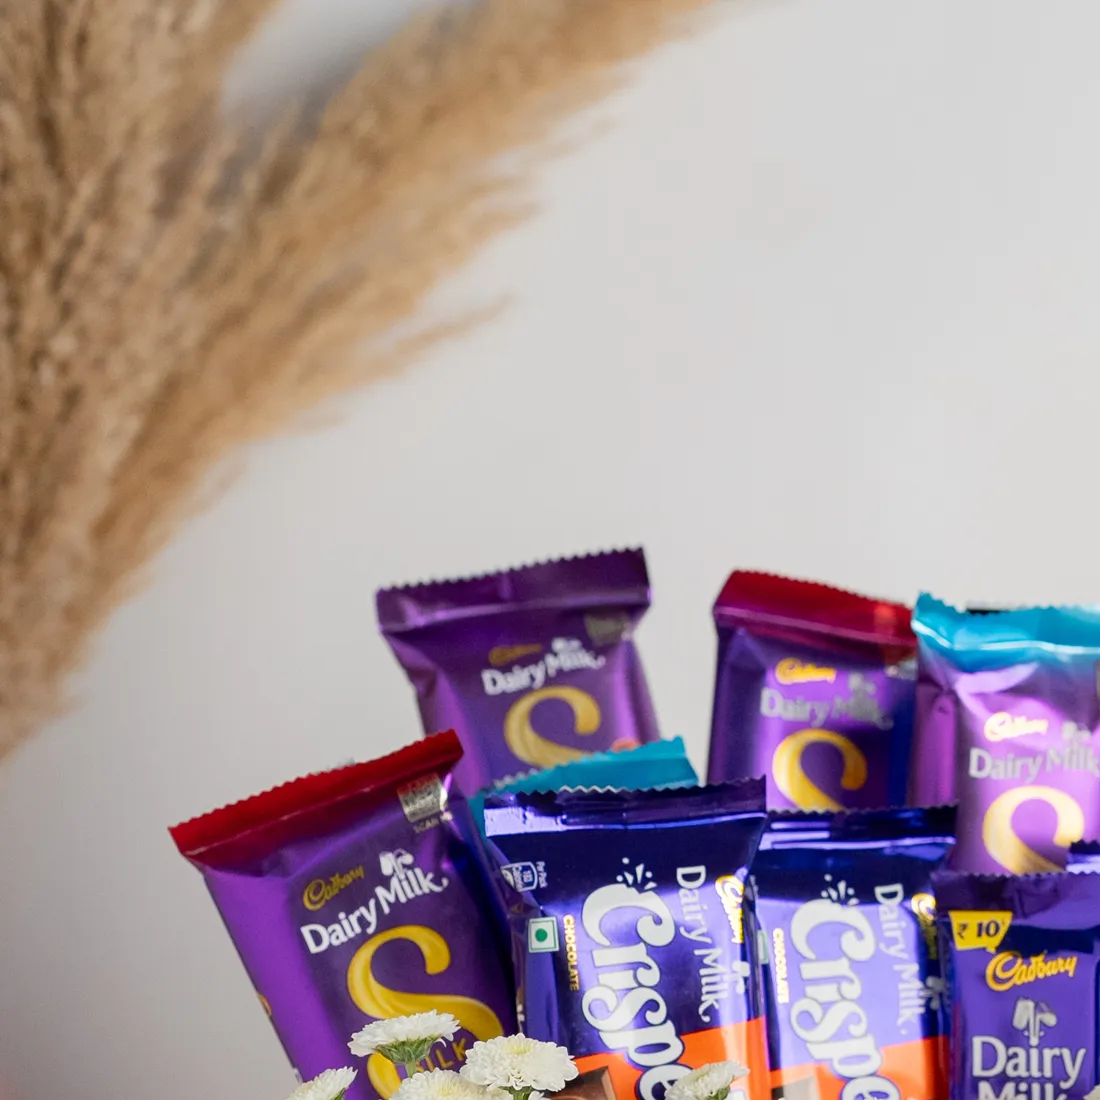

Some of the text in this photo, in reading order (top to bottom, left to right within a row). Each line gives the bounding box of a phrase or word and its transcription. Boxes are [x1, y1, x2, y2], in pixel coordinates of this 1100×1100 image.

[481, 661, 546, 695] Dairy
[969, 747, 1043, 784] Dairy
[301, 866, 449, 954] Dairy Milk
[303, 866, 365, 911] Cadbury
[563, 914, 580, 991] CHOCOLATE
[676, 865, 730, 1023] Dairy Milk
[874, 883, 926, 1036] Dairy Milk
[985, 950, 1078, 991] Cadbury
[415, 1038, 467, 1072] ILK
[971, 1035, 1087, 1090] Dairy
